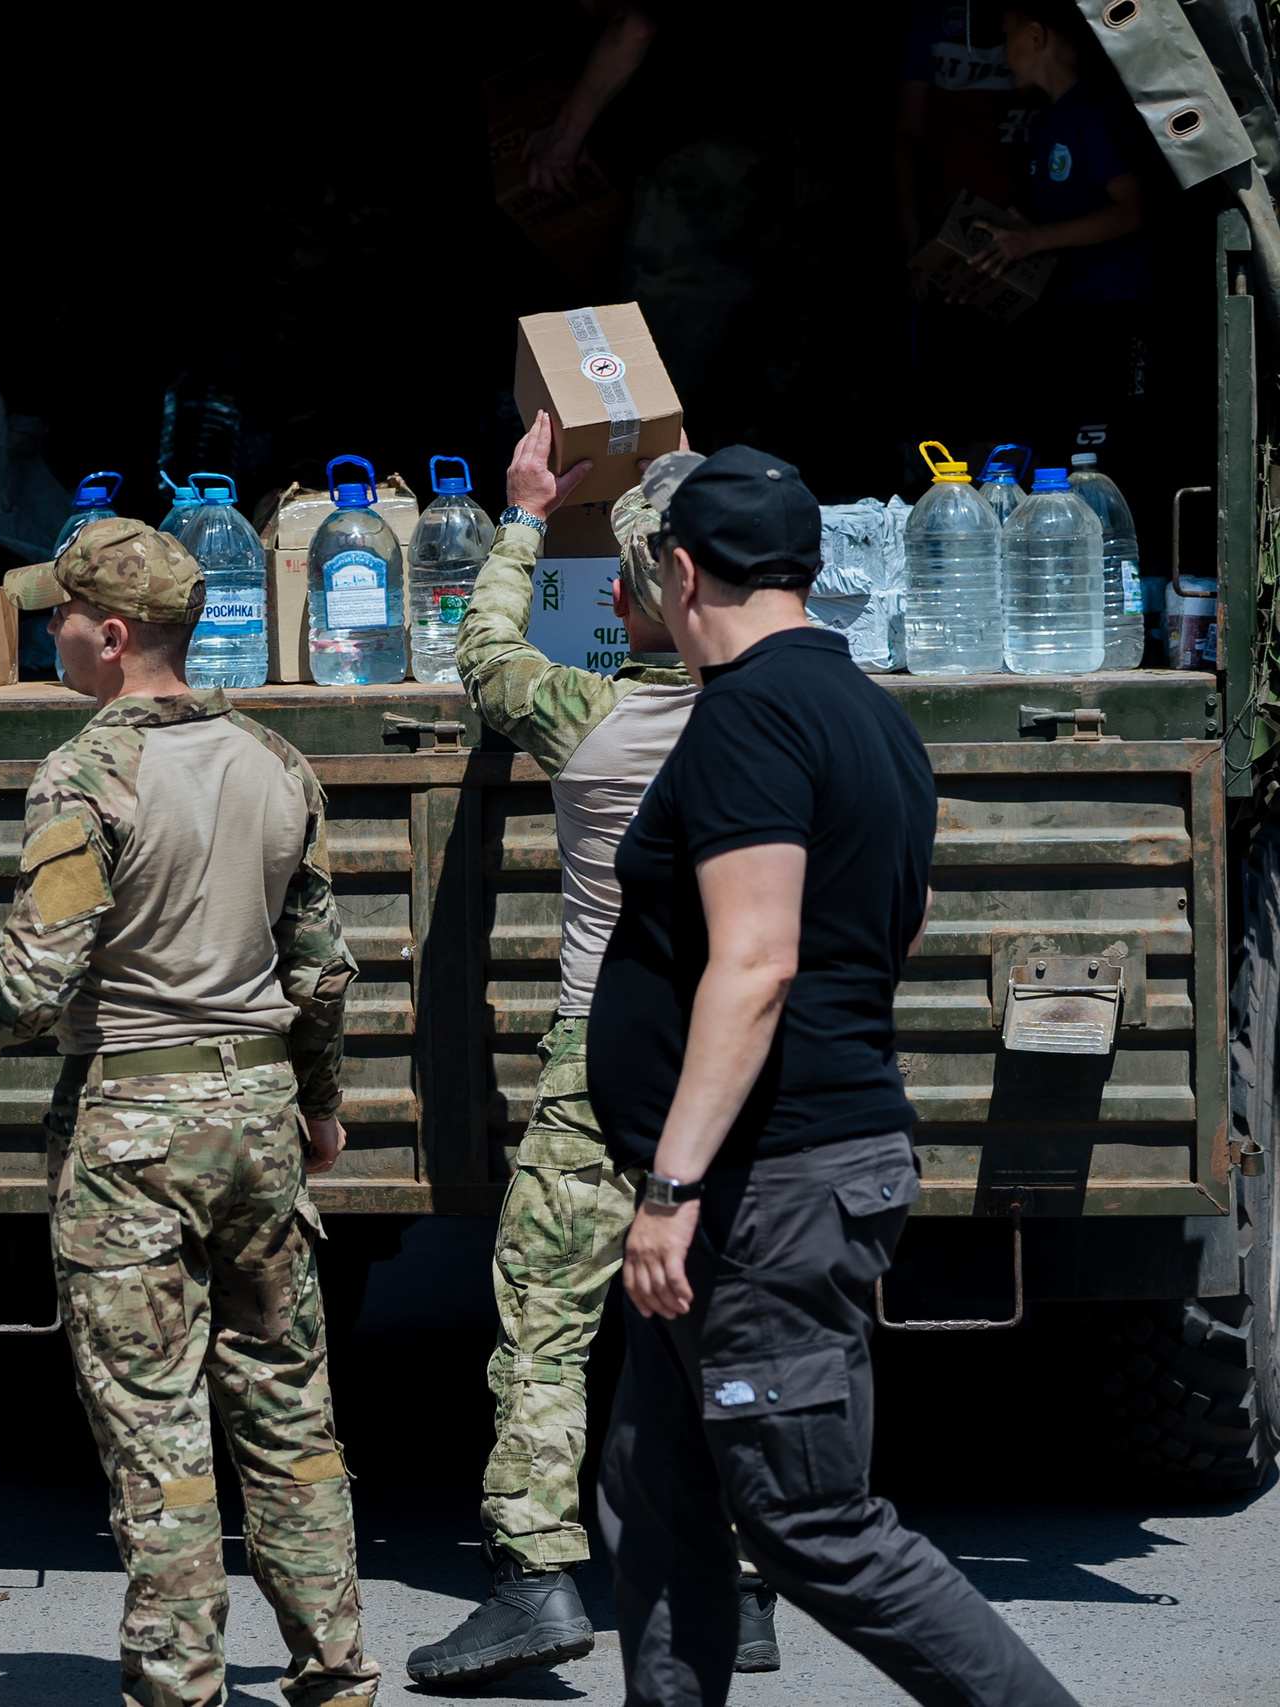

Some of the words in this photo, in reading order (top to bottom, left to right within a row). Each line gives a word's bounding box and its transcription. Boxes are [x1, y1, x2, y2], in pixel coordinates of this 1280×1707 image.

[567, 316, 588, 341] LAND
[581, 314, 599, 340] FRESH
[543, 569, 559, 611] ZDK
[205, 604, 254, 619] РОСИНКА
[593, 627, 630, 645] ЕЛЬ
[587, 651, 628, 675] ВОЙ
